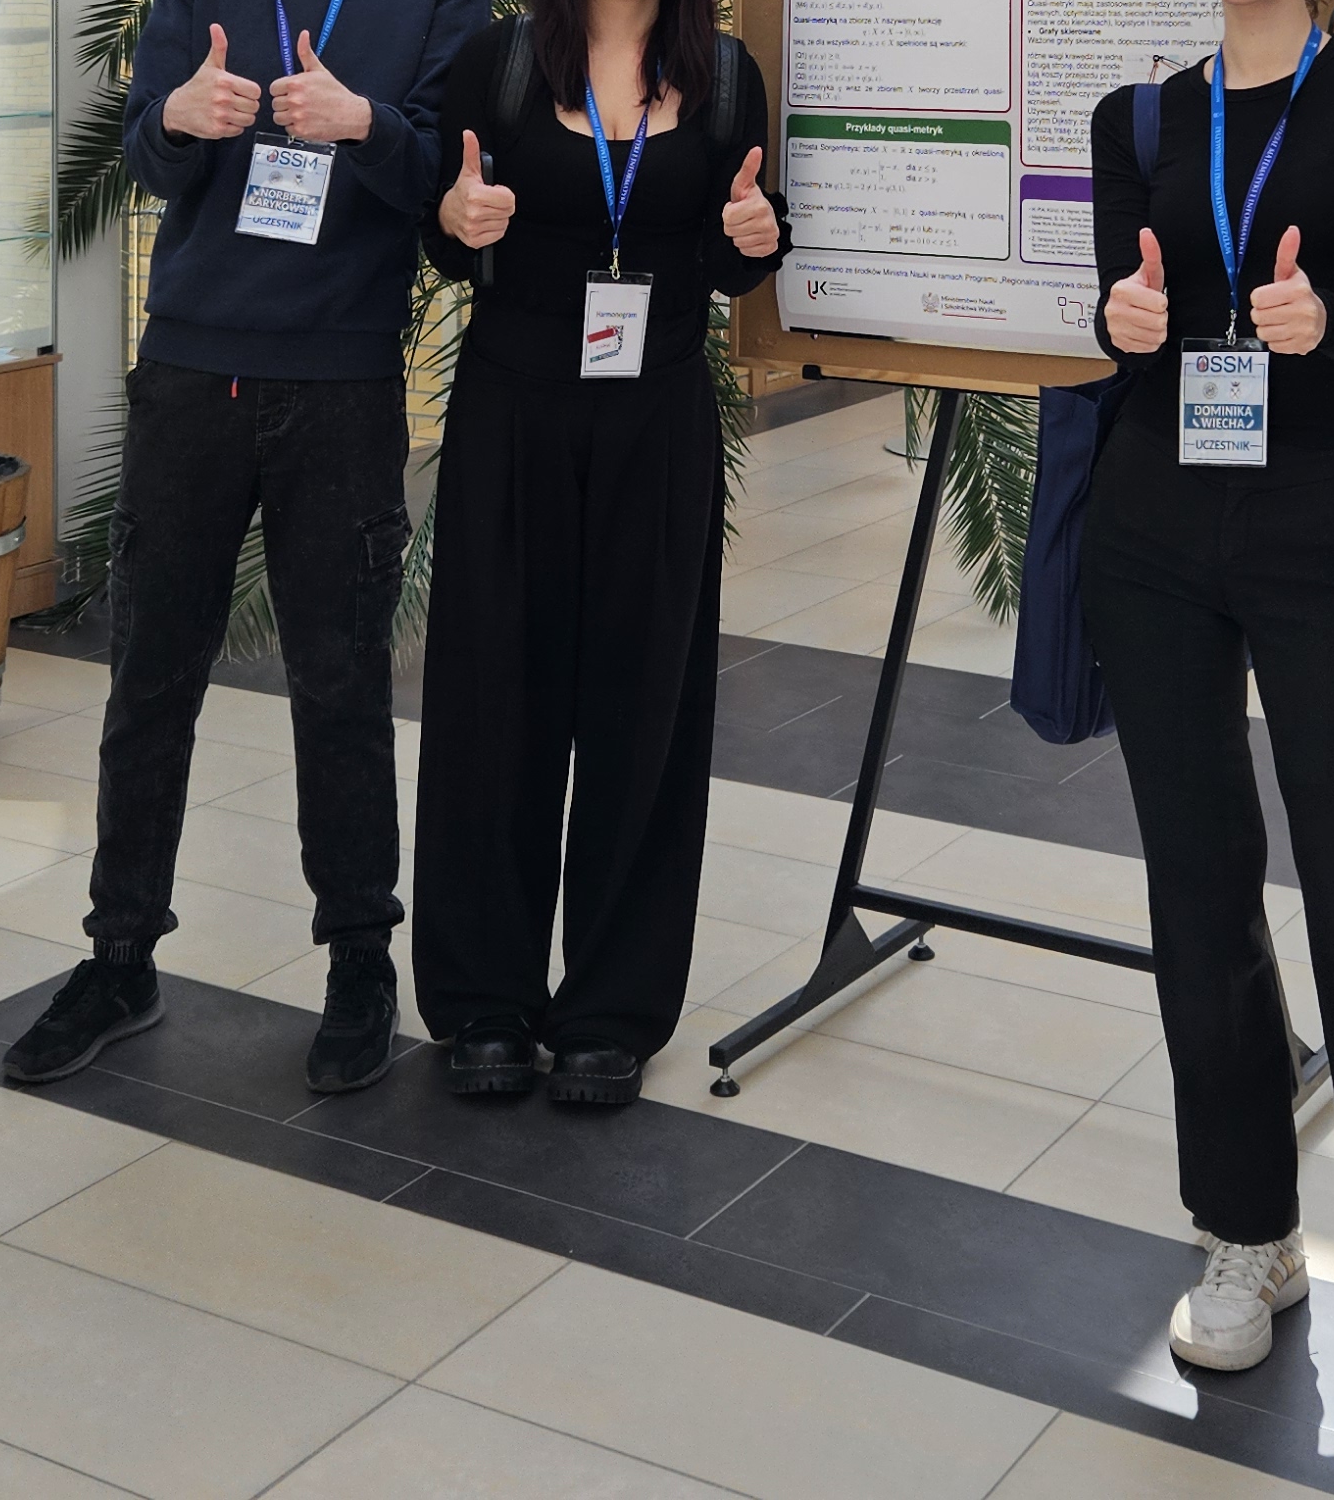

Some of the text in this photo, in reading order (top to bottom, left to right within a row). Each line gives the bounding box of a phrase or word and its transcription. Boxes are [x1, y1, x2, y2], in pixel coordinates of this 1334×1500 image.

[888, 124, 943, 137] quasi-metryk
[267, 149, 318, 169] OSSM
[261, 189, 308, 203] NORBERT
[253, 216, 303, 229] UCZESTNIK
[1196, 355, 1252, 373] OSSM
[1194, 406, 1252, 417] DOMINIKA
[1200, 418, 1245, 428] WIECHA
[1196, 440, 1250, 450] UCZESTNIK
